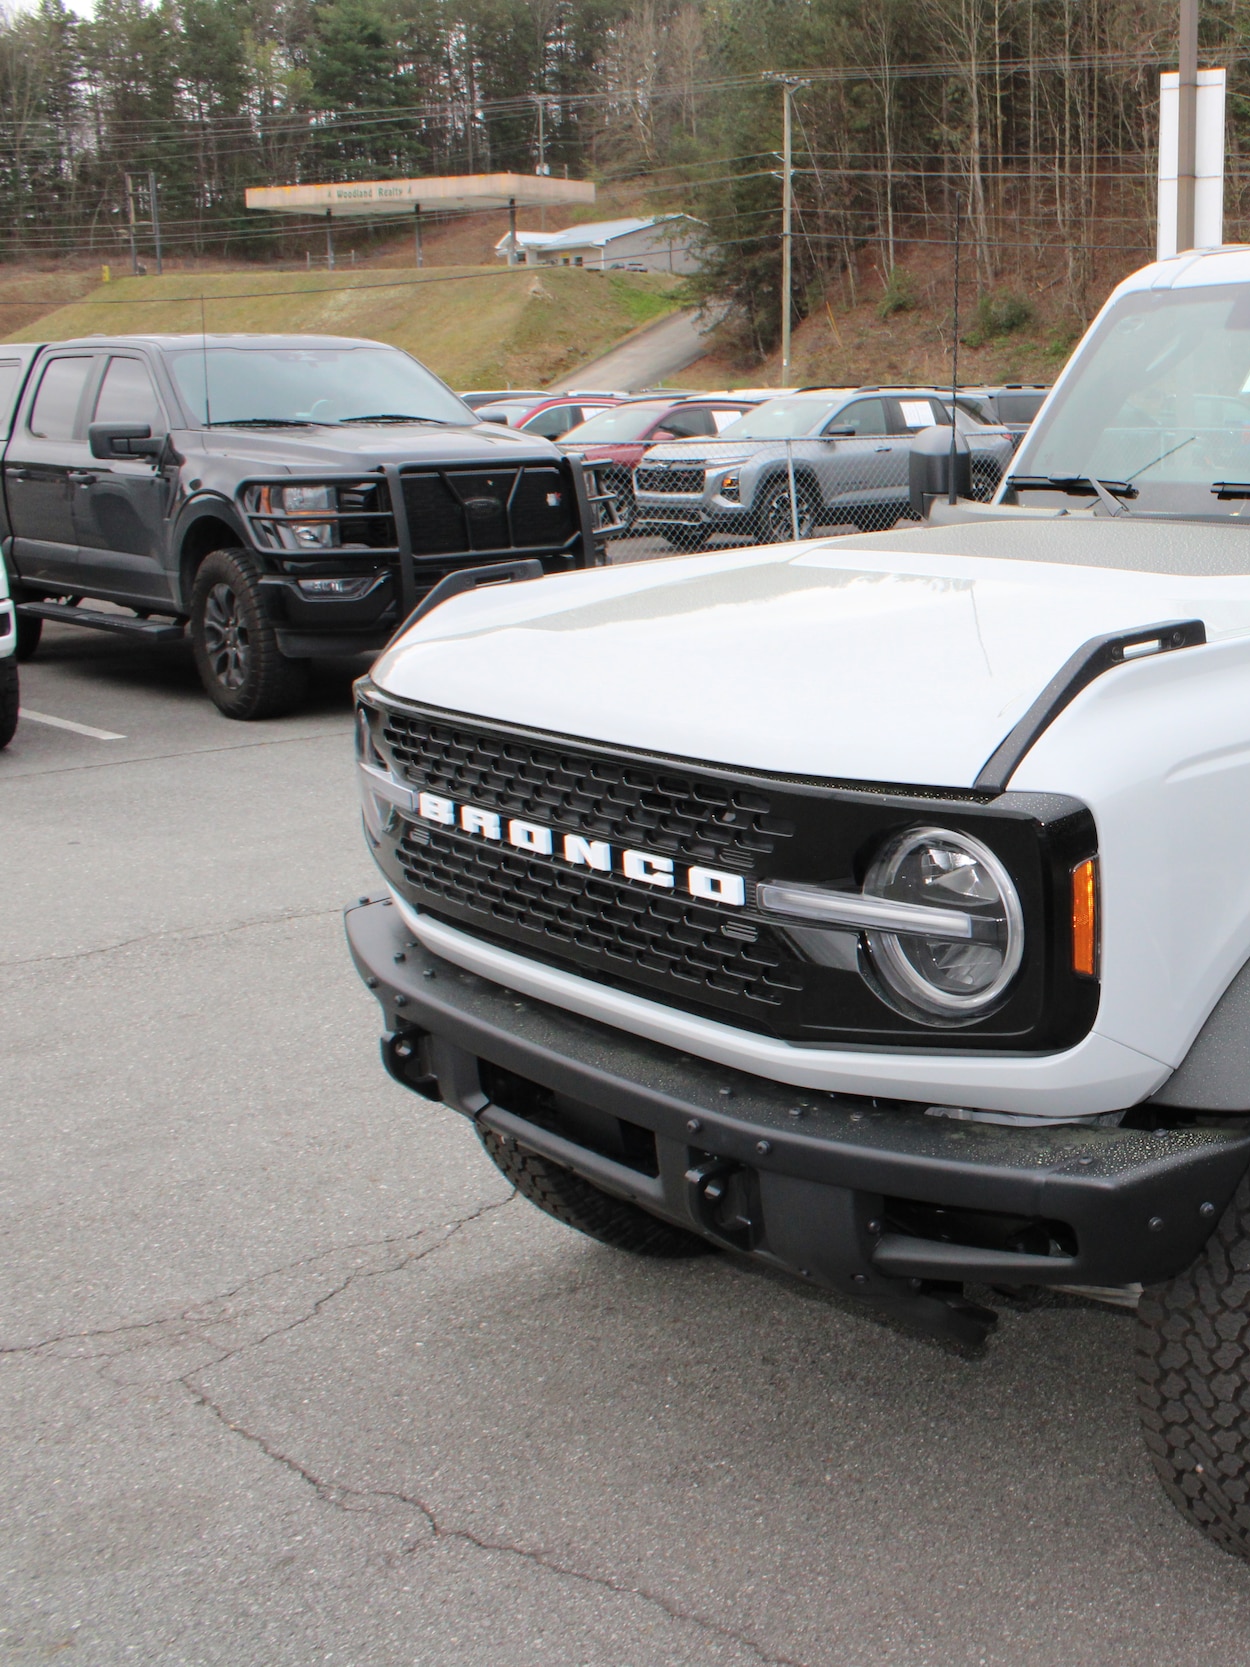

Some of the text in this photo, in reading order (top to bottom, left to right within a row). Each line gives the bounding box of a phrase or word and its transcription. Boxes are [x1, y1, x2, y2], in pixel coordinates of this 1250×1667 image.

[336, 186, 403, 199] Woodland Realty
[418, 792, 746, 906] BRONCO
